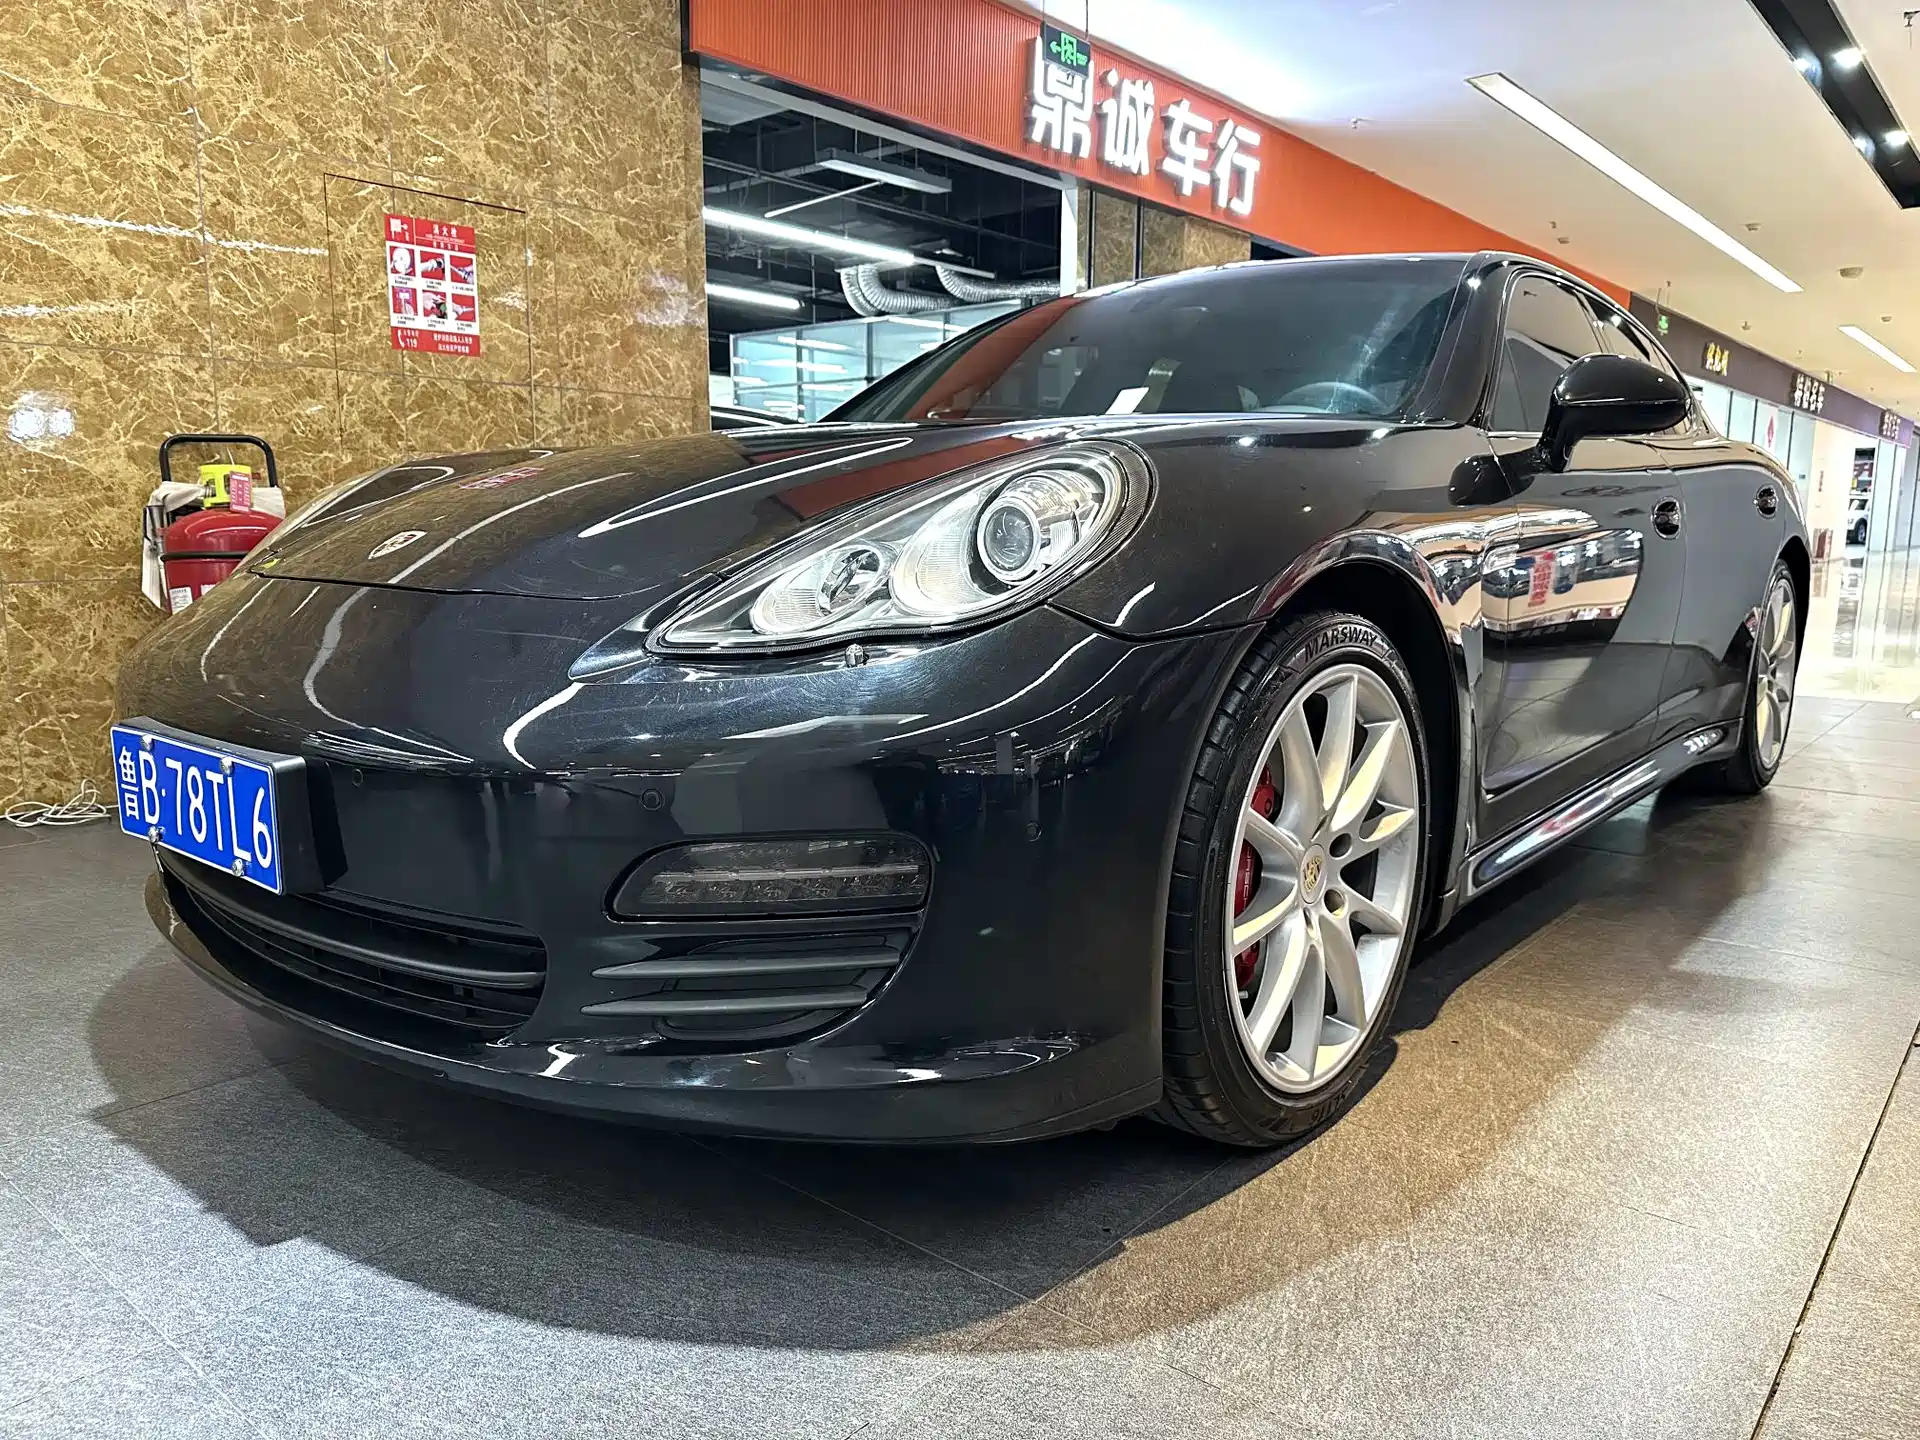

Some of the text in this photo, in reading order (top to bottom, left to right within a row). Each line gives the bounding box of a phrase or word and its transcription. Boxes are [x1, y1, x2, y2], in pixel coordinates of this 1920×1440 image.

[1032, 36, 1260, 215] 鼎诚车行
[405, 338, 418, 348] 119
[1304, 626, 1378, 663] MARSWAY
